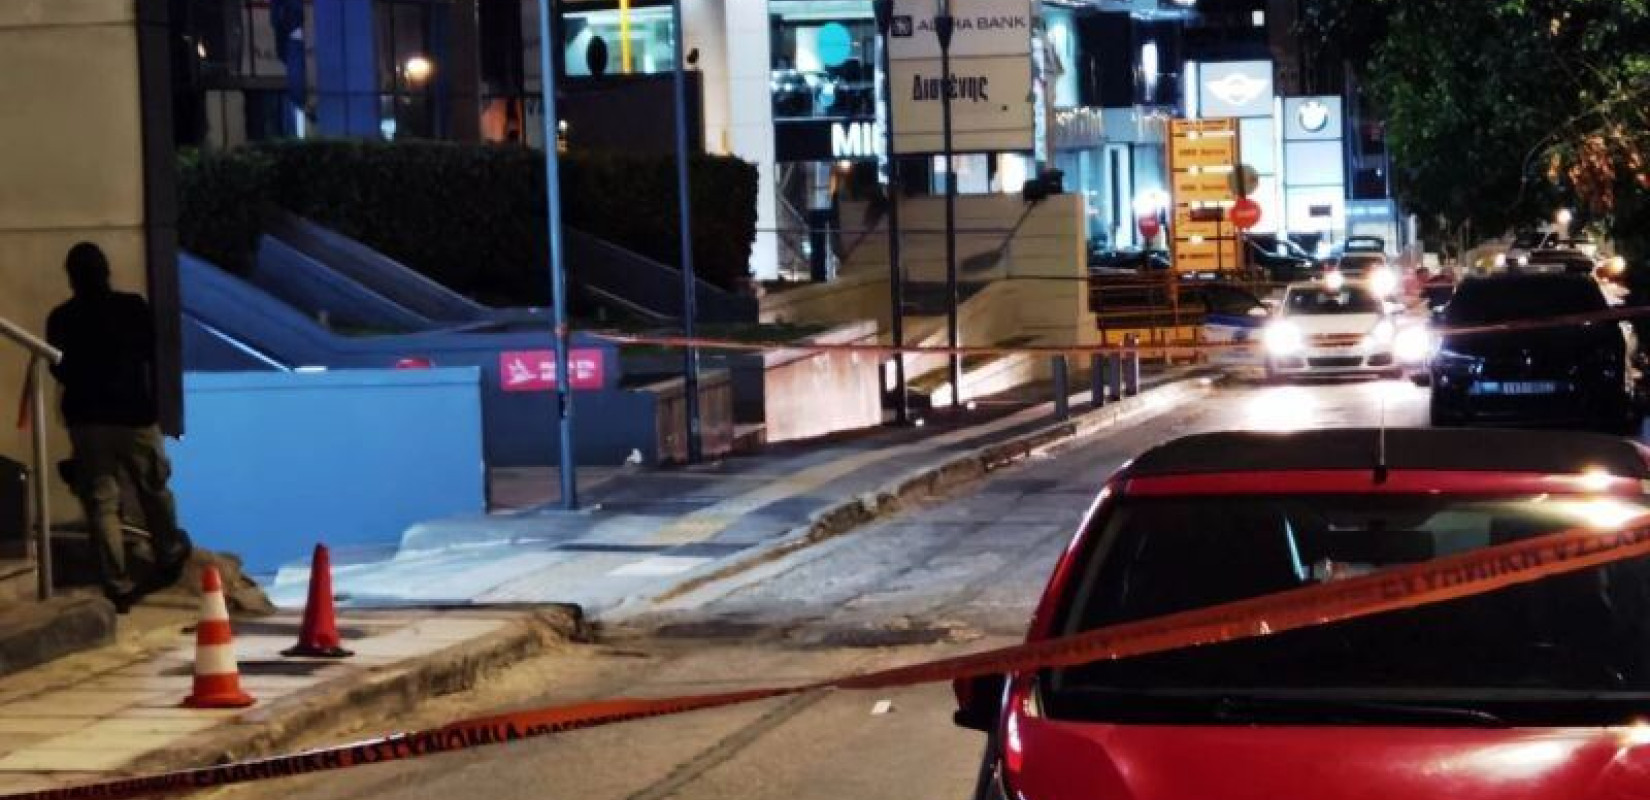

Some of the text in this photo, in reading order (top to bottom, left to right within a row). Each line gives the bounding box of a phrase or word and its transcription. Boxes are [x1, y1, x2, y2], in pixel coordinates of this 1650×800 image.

[918, 16, 1025, 31] ALHA BANK
[913, 73, 988, 102] Διοένης
